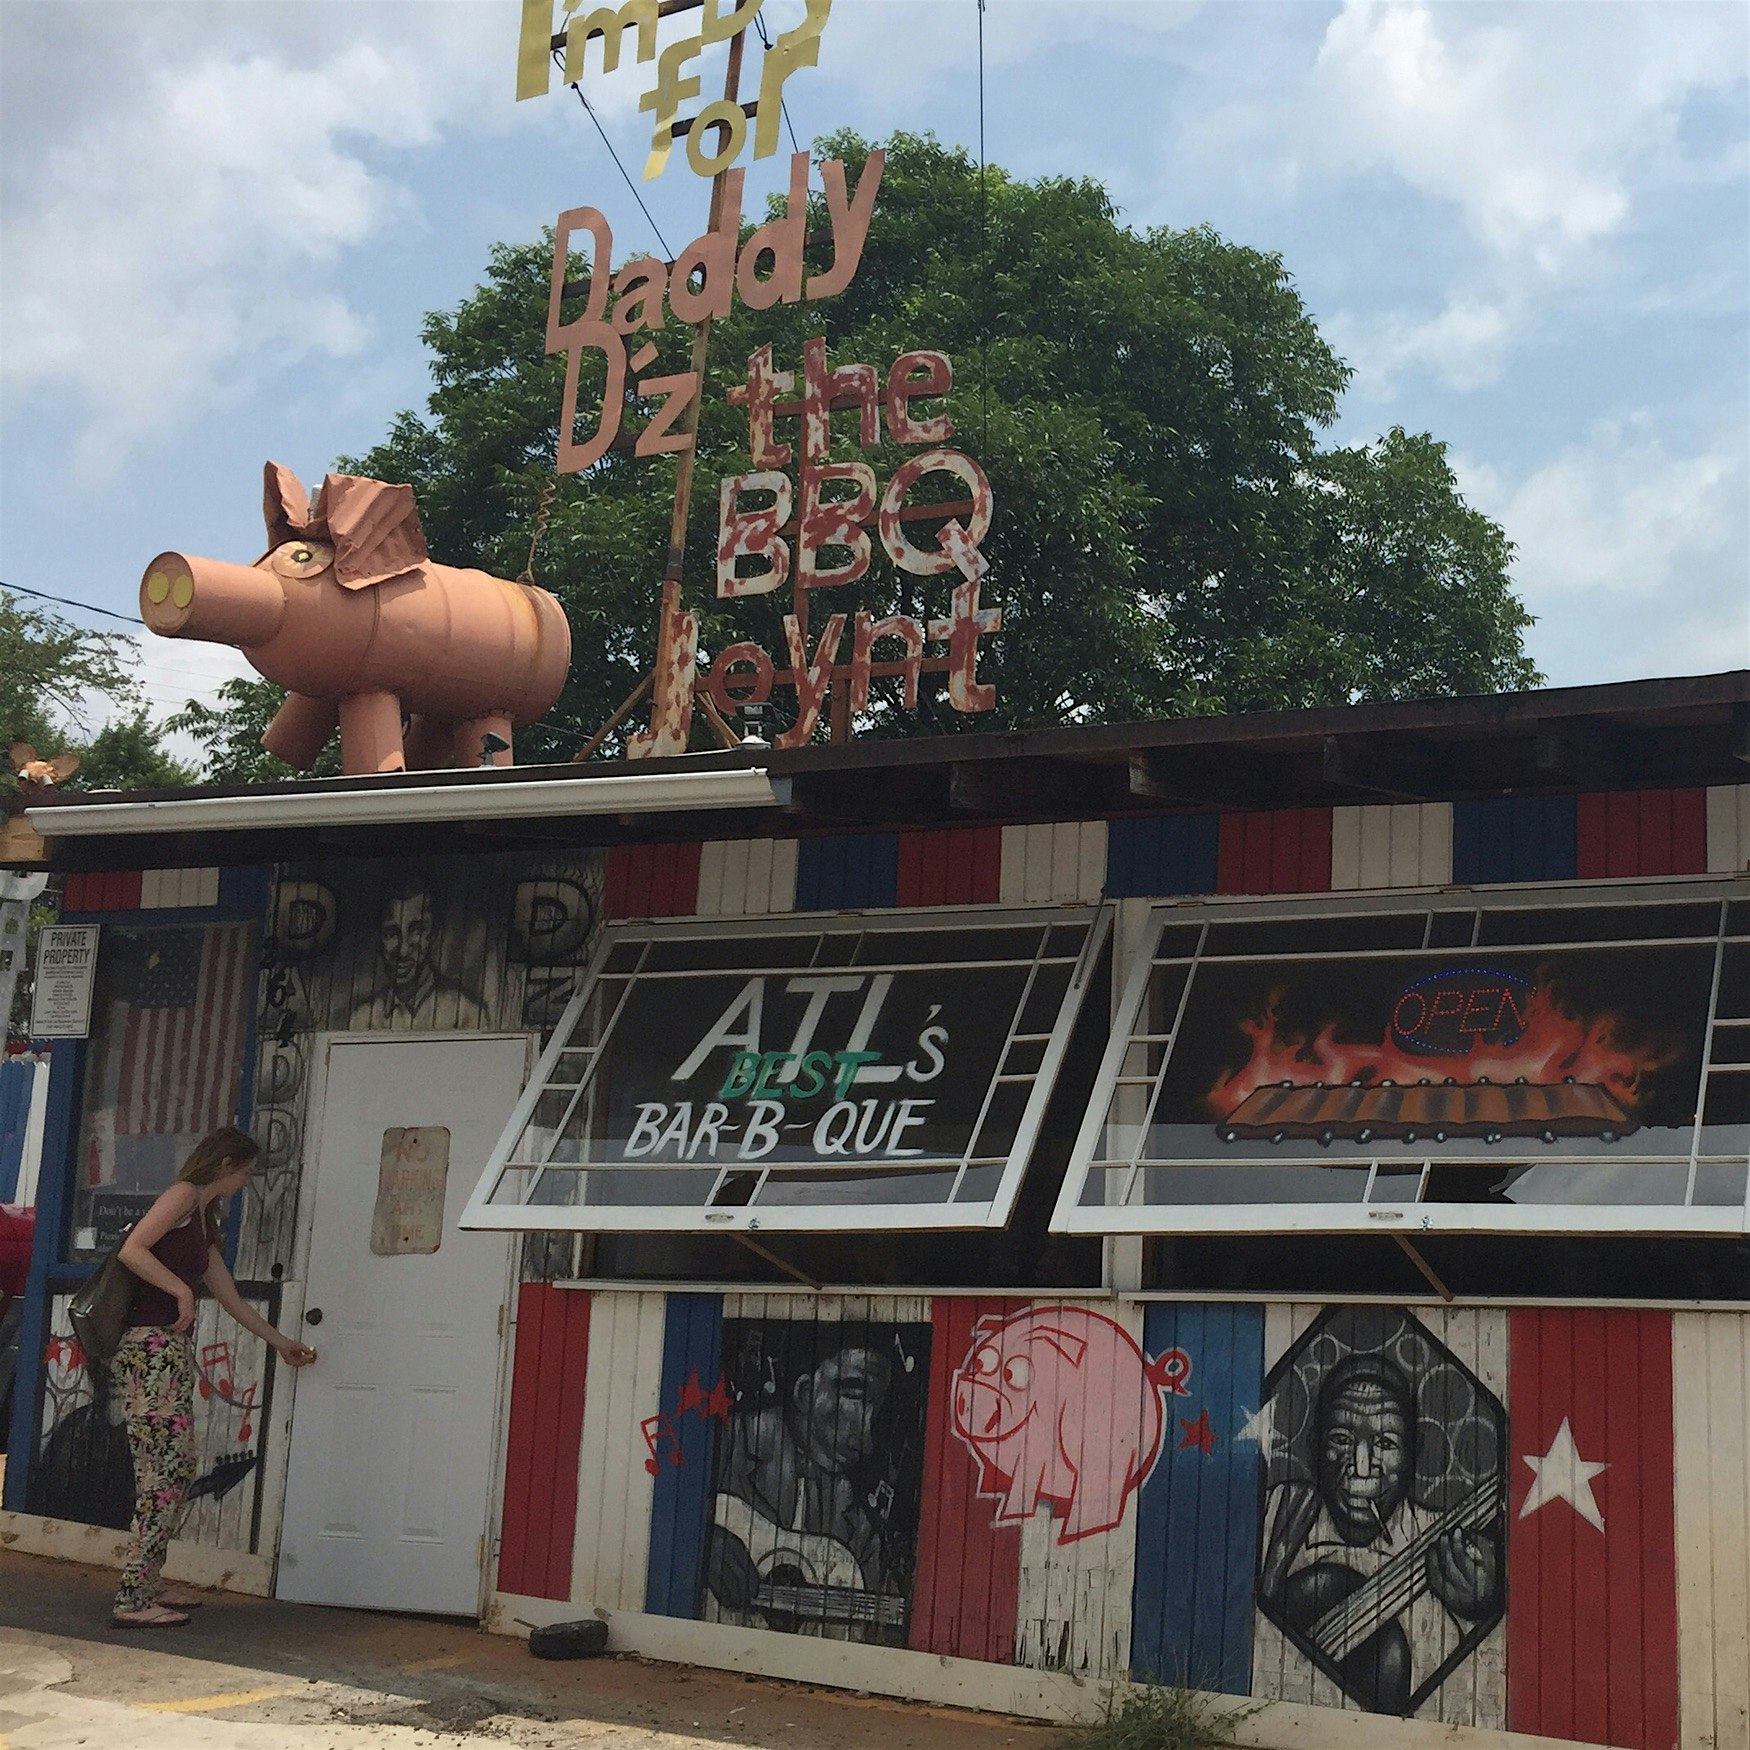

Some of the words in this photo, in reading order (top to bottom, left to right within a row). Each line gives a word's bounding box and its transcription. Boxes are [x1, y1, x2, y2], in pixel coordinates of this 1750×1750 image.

[639, 35, 820, 181] for
[545, 149, 885, 355] Daddy
[557, 319, 698, 474] D'z
[727, 336, 955, 468] the
[717, 449, 993, 597] BBQ
[628, 581, 1001, 760] Joynt
[43, 948, 91, 964] PROPERTY
[51, 931, 87, 946] PRIVATE
[1393, 987, 1535, 1036] OPEN
[718, 1051, 882, 1100] BEST
[623, 1099, 935, 1160] BAR-B-QUE
[100, 1205, 122, 1217] Don't
